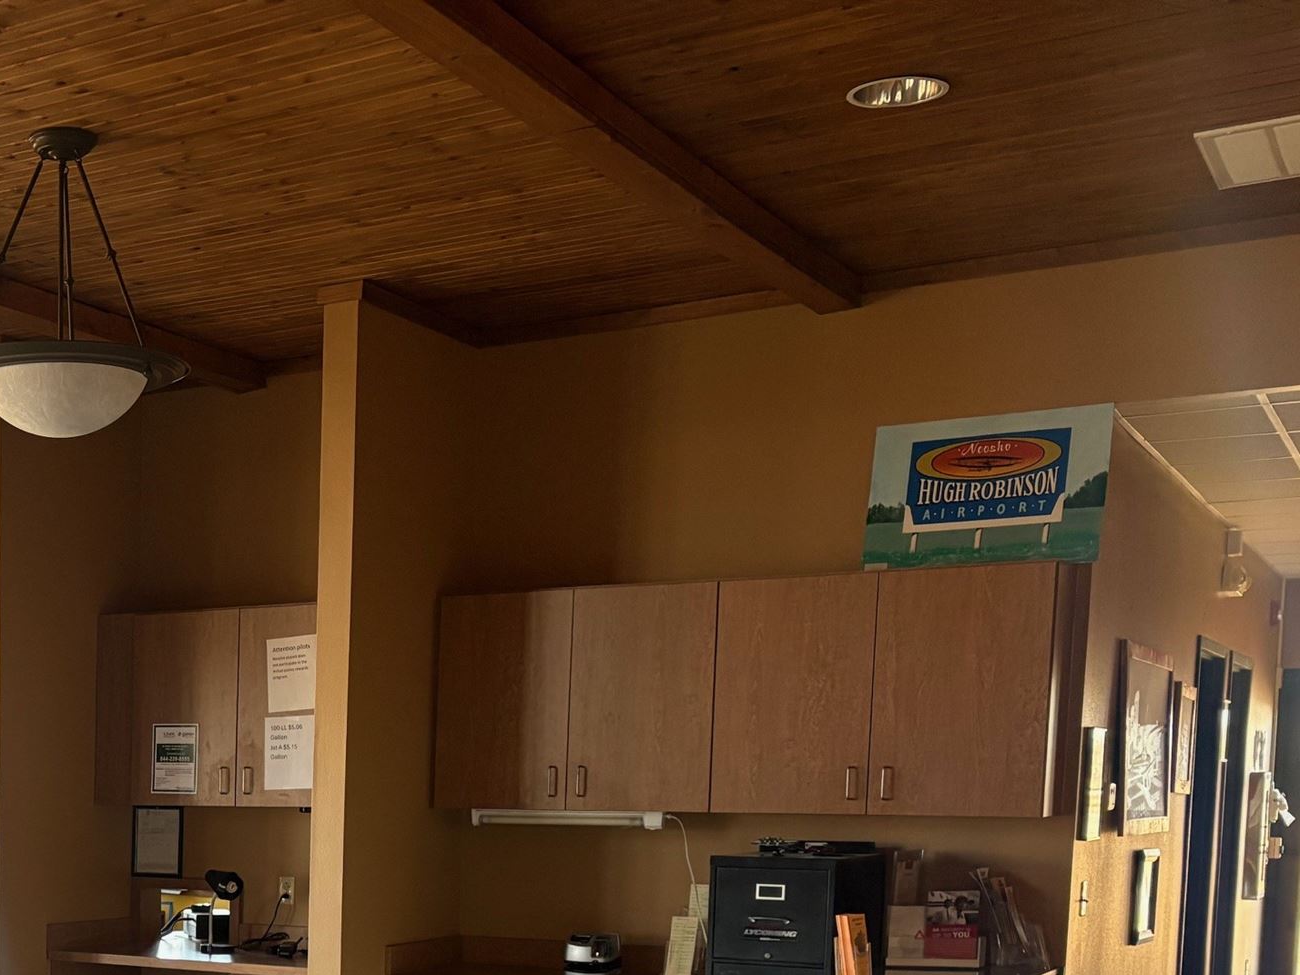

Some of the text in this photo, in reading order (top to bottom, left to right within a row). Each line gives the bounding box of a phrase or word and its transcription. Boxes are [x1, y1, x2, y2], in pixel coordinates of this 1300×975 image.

[962, 440, 1012, 456] Neosho
[917, 466, 1060, 505] HUGH ROBINSON
[272, 645, 296, 653] Attention
